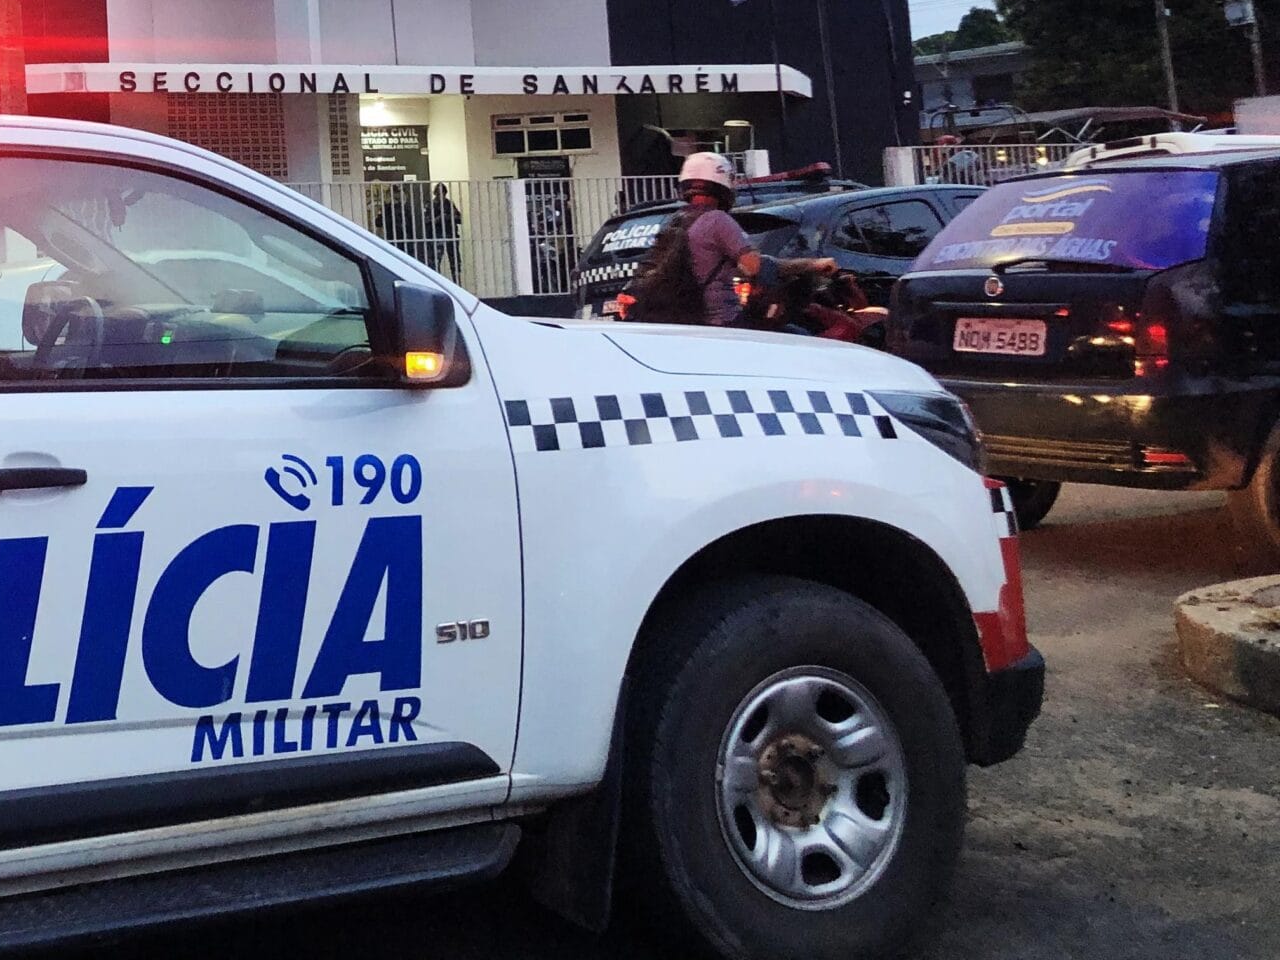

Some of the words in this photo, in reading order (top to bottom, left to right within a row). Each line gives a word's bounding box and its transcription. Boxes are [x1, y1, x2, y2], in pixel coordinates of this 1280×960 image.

[119, 71, 379, 93] SECCIONAL
[430, 73, 475, 95] DE
[391, 128, 418, 136] CIVIL
[1002, 198, 1095, 224] portal
[601, 237, 649, 253] MILITAR
[326, 454, 422, 507] 190
[435, 619, 490, 645] S10
[190, 695, 422, 762] MILITAR
